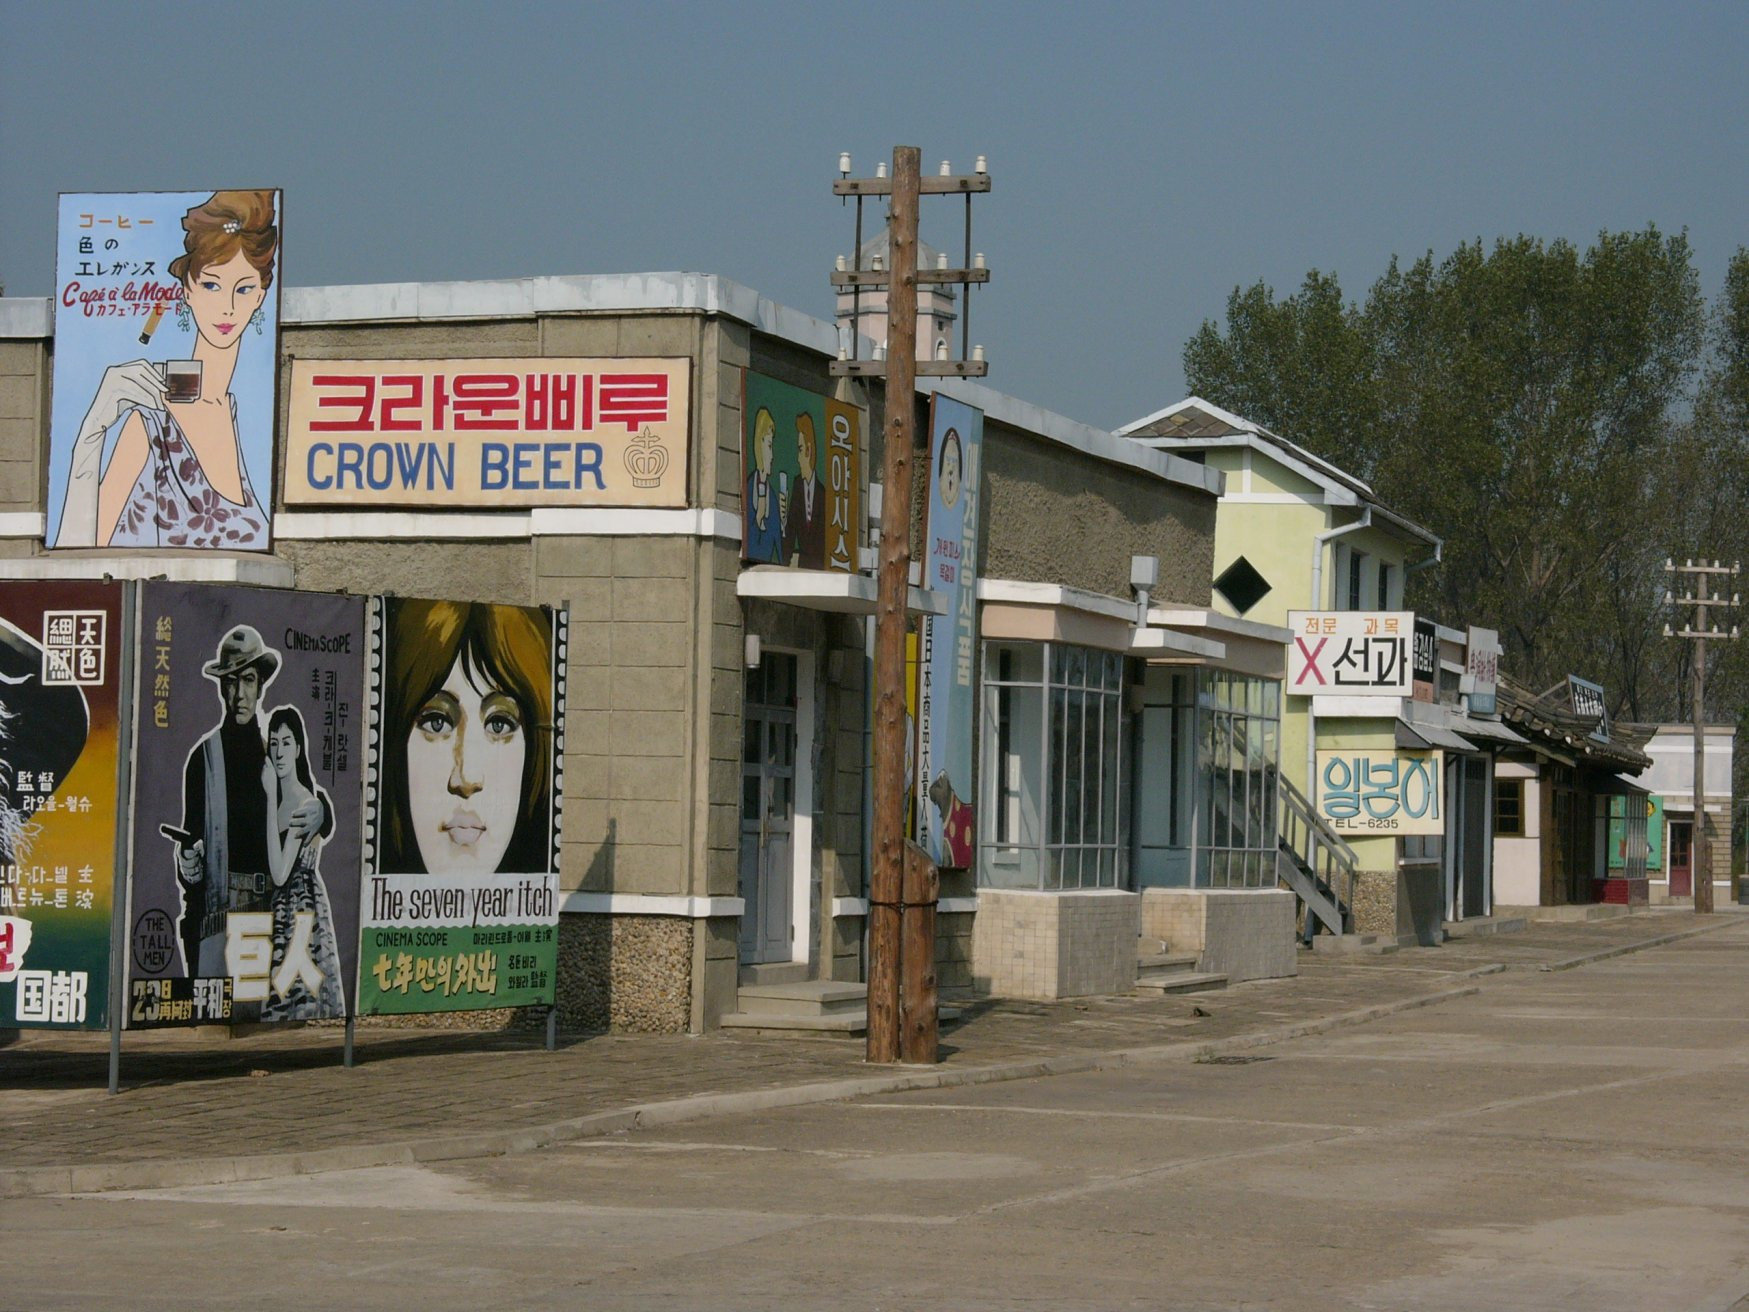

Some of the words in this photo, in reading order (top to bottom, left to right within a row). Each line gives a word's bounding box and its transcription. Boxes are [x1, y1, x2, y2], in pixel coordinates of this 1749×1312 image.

[79, 213, 154, 229] コーヒー
[74, 260, 156, 276] エレガンス
[121, 281, 137, 301] la
[138, 281, 185, 301] Mode
[308, 373, 669, 432] 크라운삐루
[306, 442, 455, 491] CROWN
[480, 442, 607, 491] BEER
[831, 414, 853, 572] 오아시스
[1305, 617, 1337, 635] 전문
[1363, 617, 1399, 635] 과목
[1323, 756, 1440, 820] 일본어
[371, 877, 403, 921] The
[408, 887, 465, 920] seven
[470, 887, 514, 929] year
[517, 876, 552, 917] itch
[144, 917, 165, 932] THE
[140, 933, 171, 949] TALL
[375, 932, 414, 948] CINEMA
[415, 932, 448, 947] SCOPE
[143, 951, 165, 966] MEN
[225, 911, 323, 1002] 巨人
